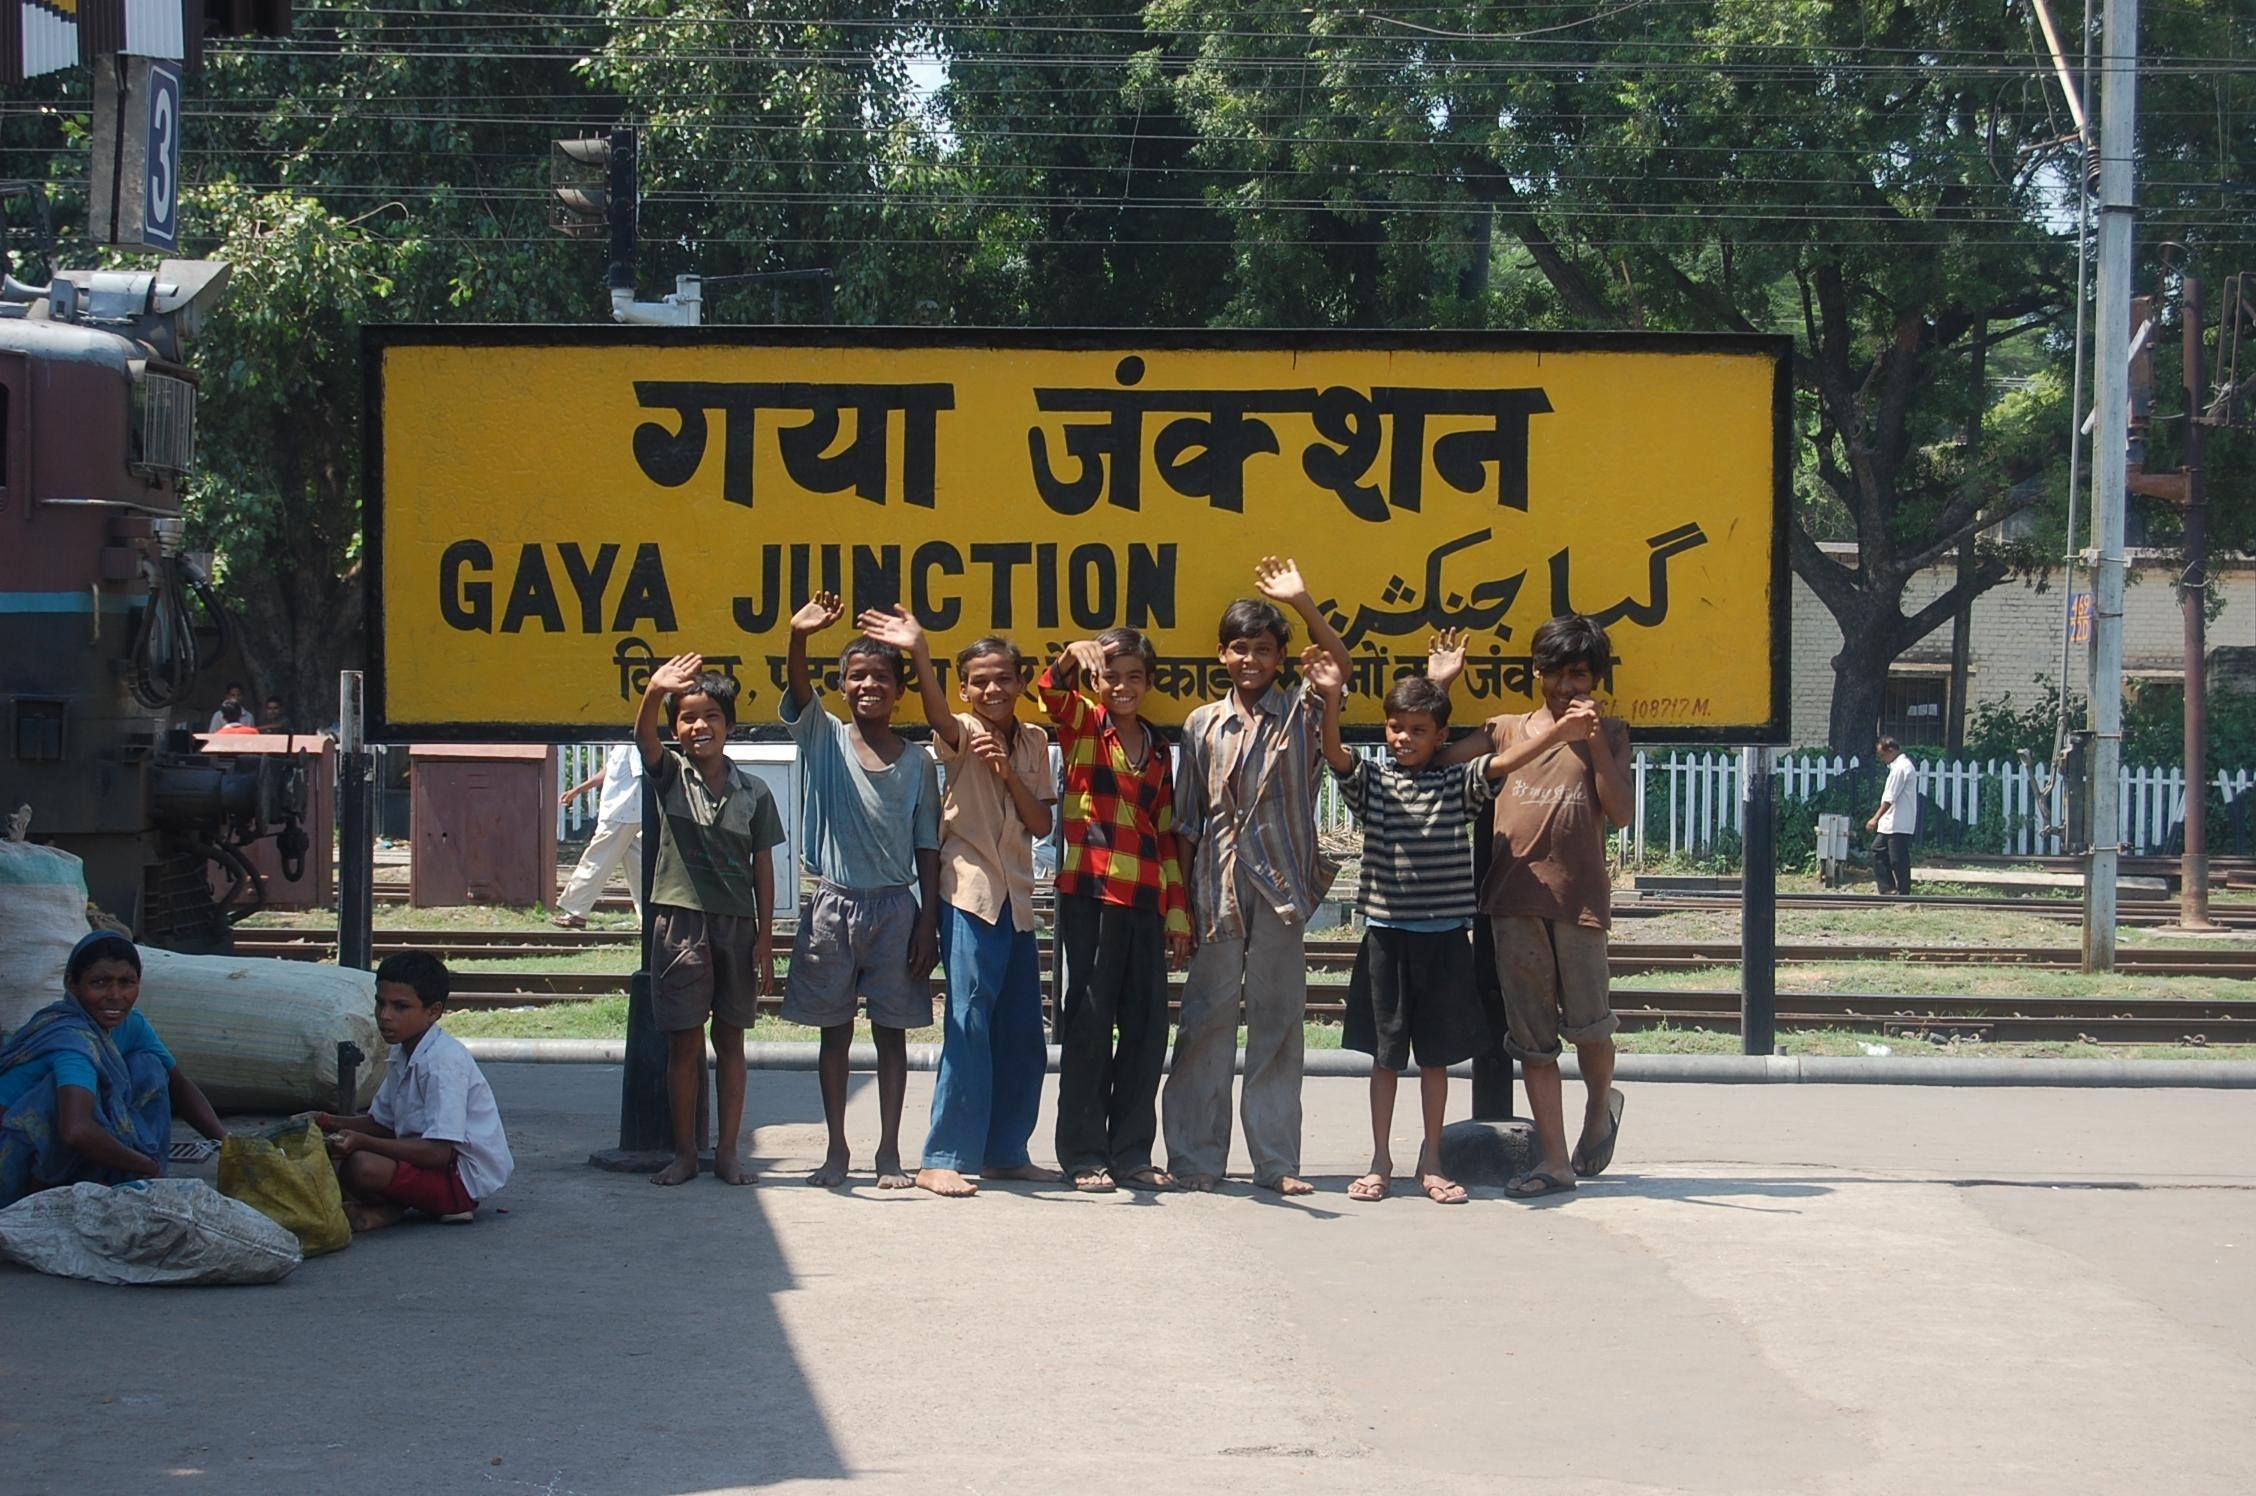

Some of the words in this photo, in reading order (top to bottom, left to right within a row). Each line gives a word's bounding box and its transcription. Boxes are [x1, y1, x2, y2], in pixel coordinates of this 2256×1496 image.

[153, 87, 172, 224] 3
[632, 380, 956, 509] गया
[1028, 355, 1555, 523] जंक्शन
[439, 538, 678, 635] GAYA
[732, 540, 1178, 634] JUNCTION
